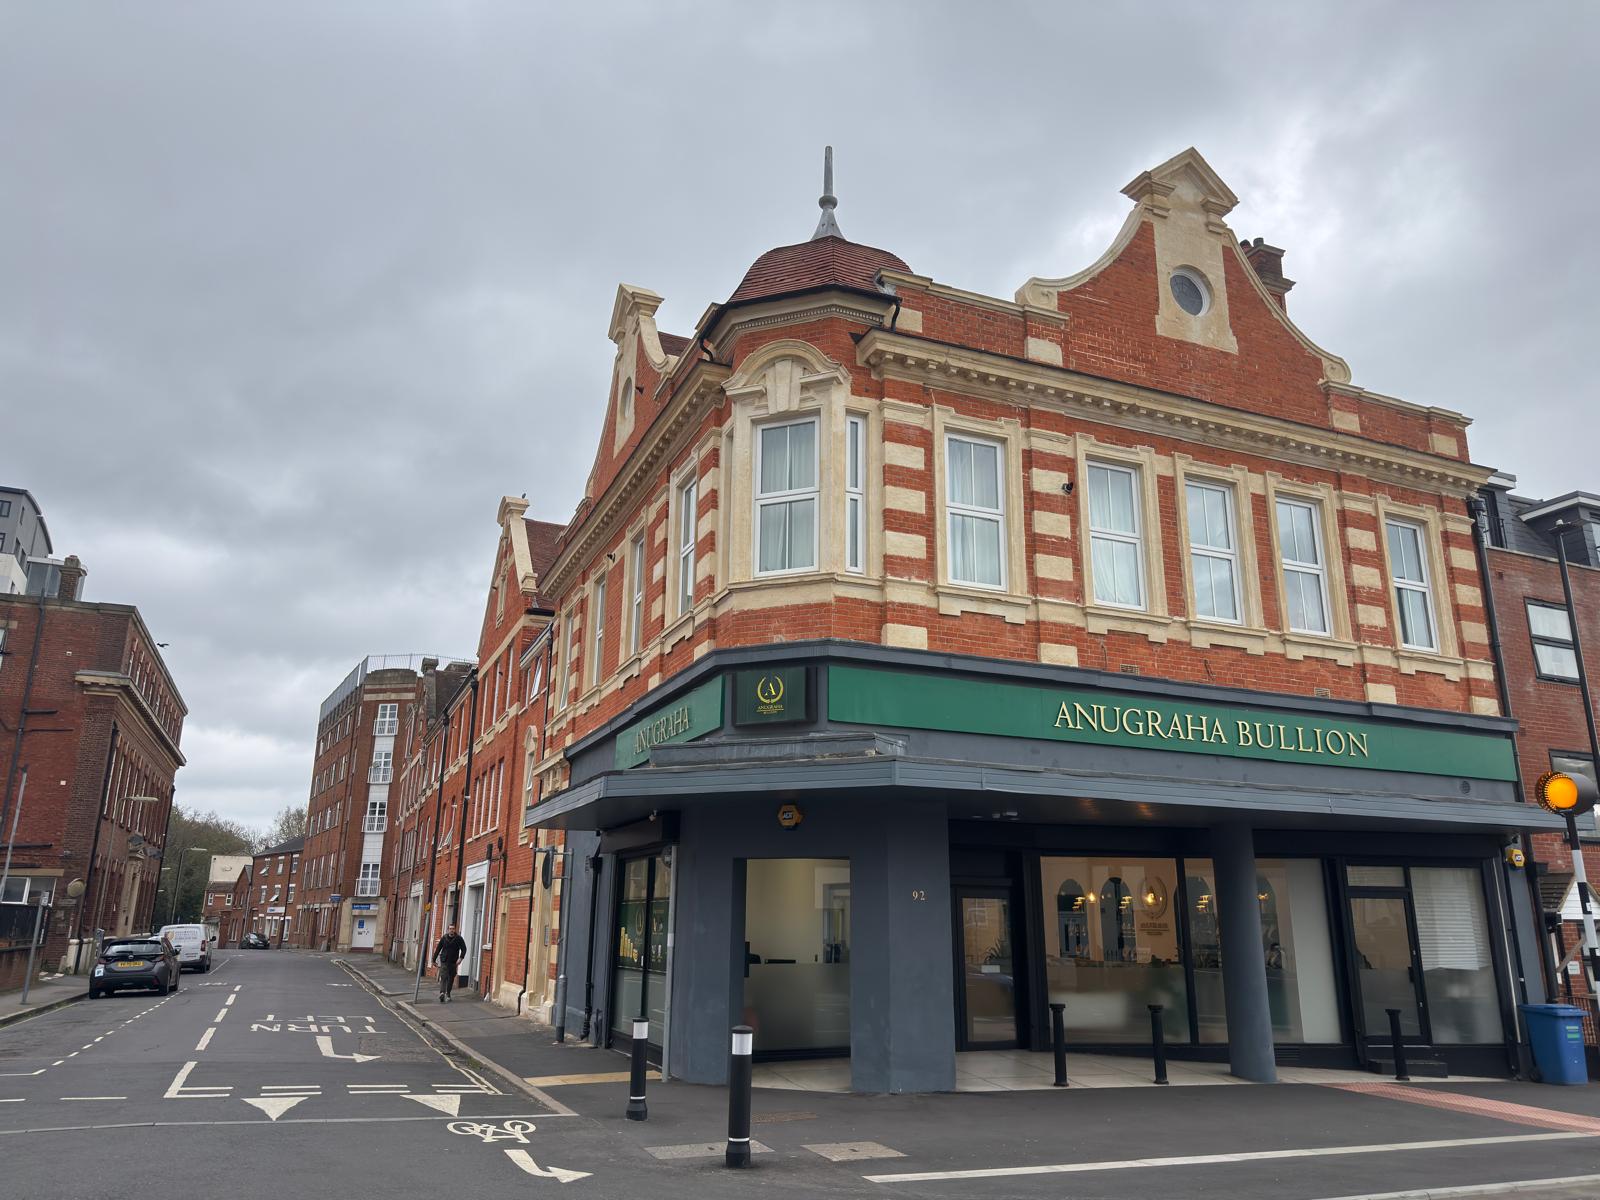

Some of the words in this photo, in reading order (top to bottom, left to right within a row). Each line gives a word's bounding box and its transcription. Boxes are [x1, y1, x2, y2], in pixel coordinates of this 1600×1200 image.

[633, 705, 690, 755] ANUGRAHA
[1054, 701, 1229, 744] ANUGRAHA
[1236, 720, 1369, 758] BULLION
[912, 890, 925, 901] 92
[256, 1014, 376, 1023] LEFT
[250, 1024, 387, 1034] TURN
